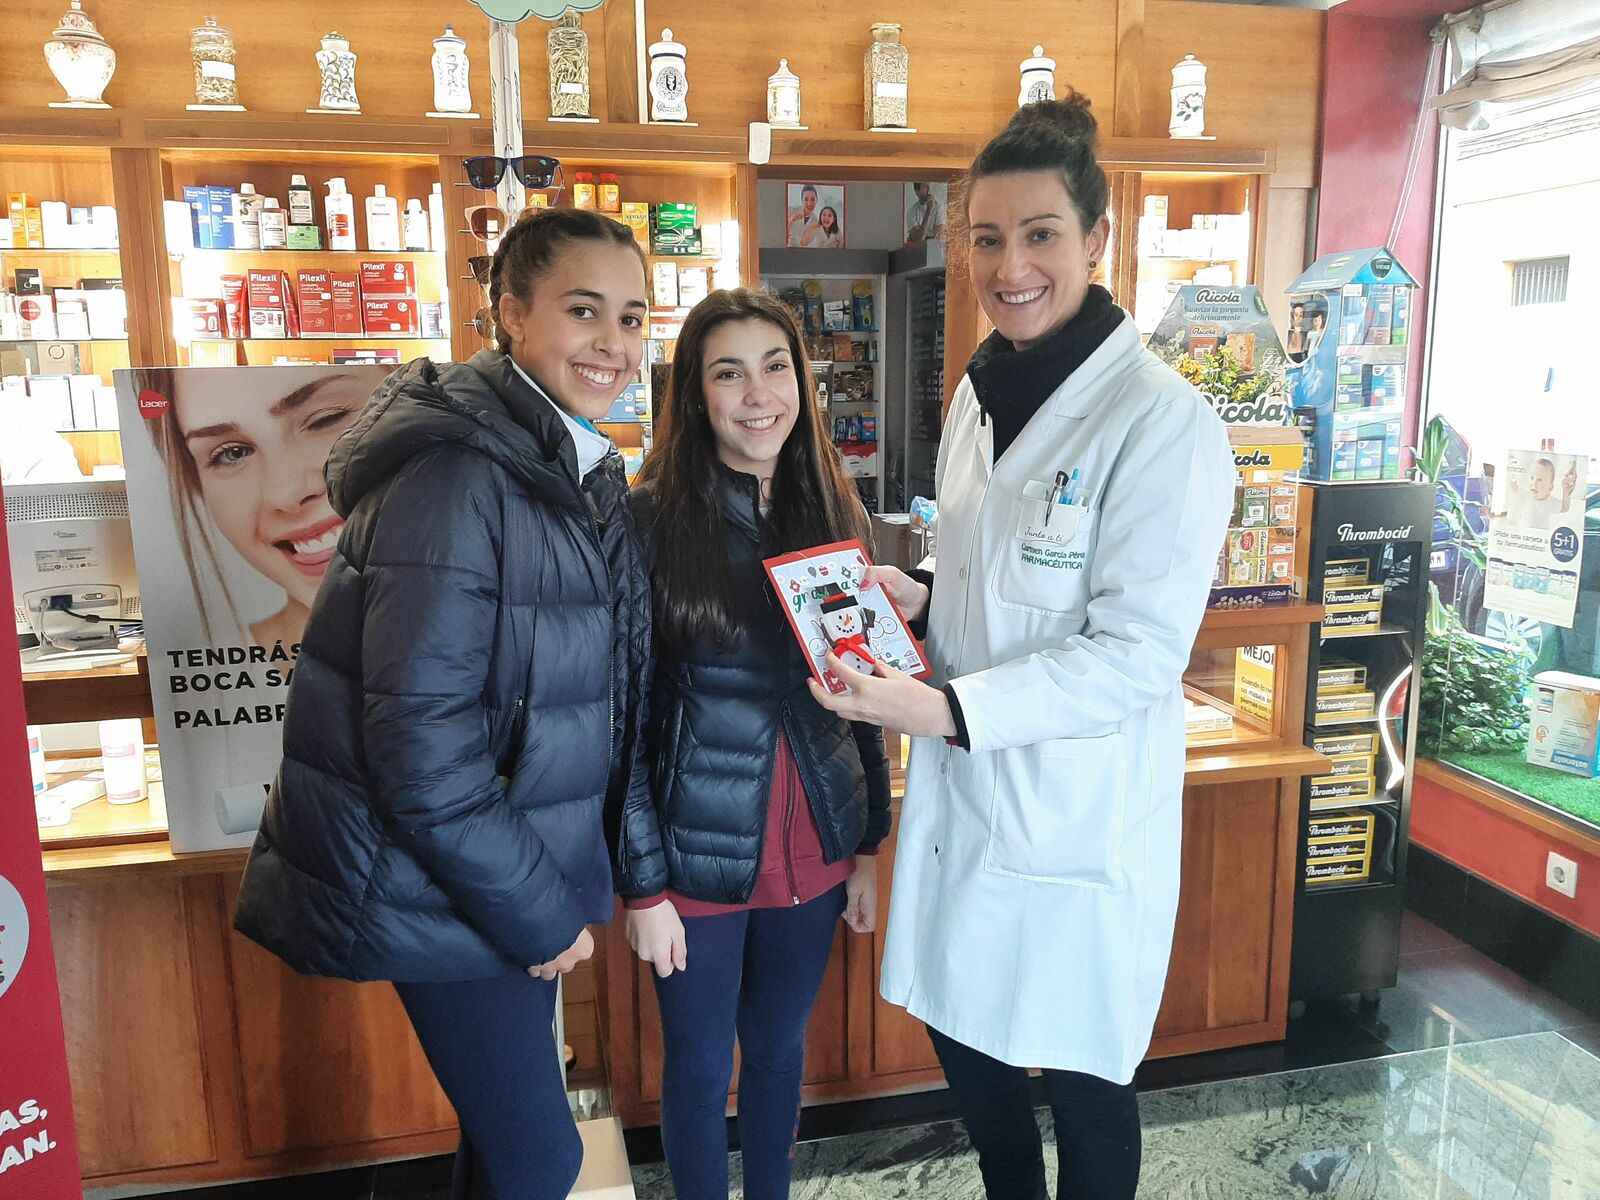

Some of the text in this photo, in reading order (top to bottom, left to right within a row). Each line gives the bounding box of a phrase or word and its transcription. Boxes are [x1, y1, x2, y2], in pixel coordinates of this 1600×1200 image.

[363, 263, 386, 271] Pilexil
[250, 274, 277, 282] Pilexil
[299, 274, 327, 282] Pilexil
[333, 280, 356, 288] Pilexil
[1196, 290, 1240, 303] Ricola
[366, 302, 390, 310] Pilexil
[1219, 305, 1249, 315] garganta
[140, 400, 168, 408] Lacer
[1203, 395, 1284, 423] icola
[1337, 523, 1412, 542] Thrombocid
[1553, 532, 1576, 549] 5+1
[1021, 543, 1043, 556] Carmen
[1045, 549, 1067, 559] García
[1021, 553, 1083, 570] FARMACÉUTICA
[1325, 590, 1371, 603] Thrombocid
[1324, 613, 1369, 625] Thrombocid
[170, 671, 255, 694] BOCA
[1316, 700, 1356, 710] Thrombocid
[1314, 742, 1356, 753] Thrombocid
[1310, 785, 1352, 797] Thrombocid
[1308, 824, 1352, 836] Thrombocid
[1307, 845, 1350, 857] Thrombocid
[1305, 865, 1348, 877] Thrombocid
